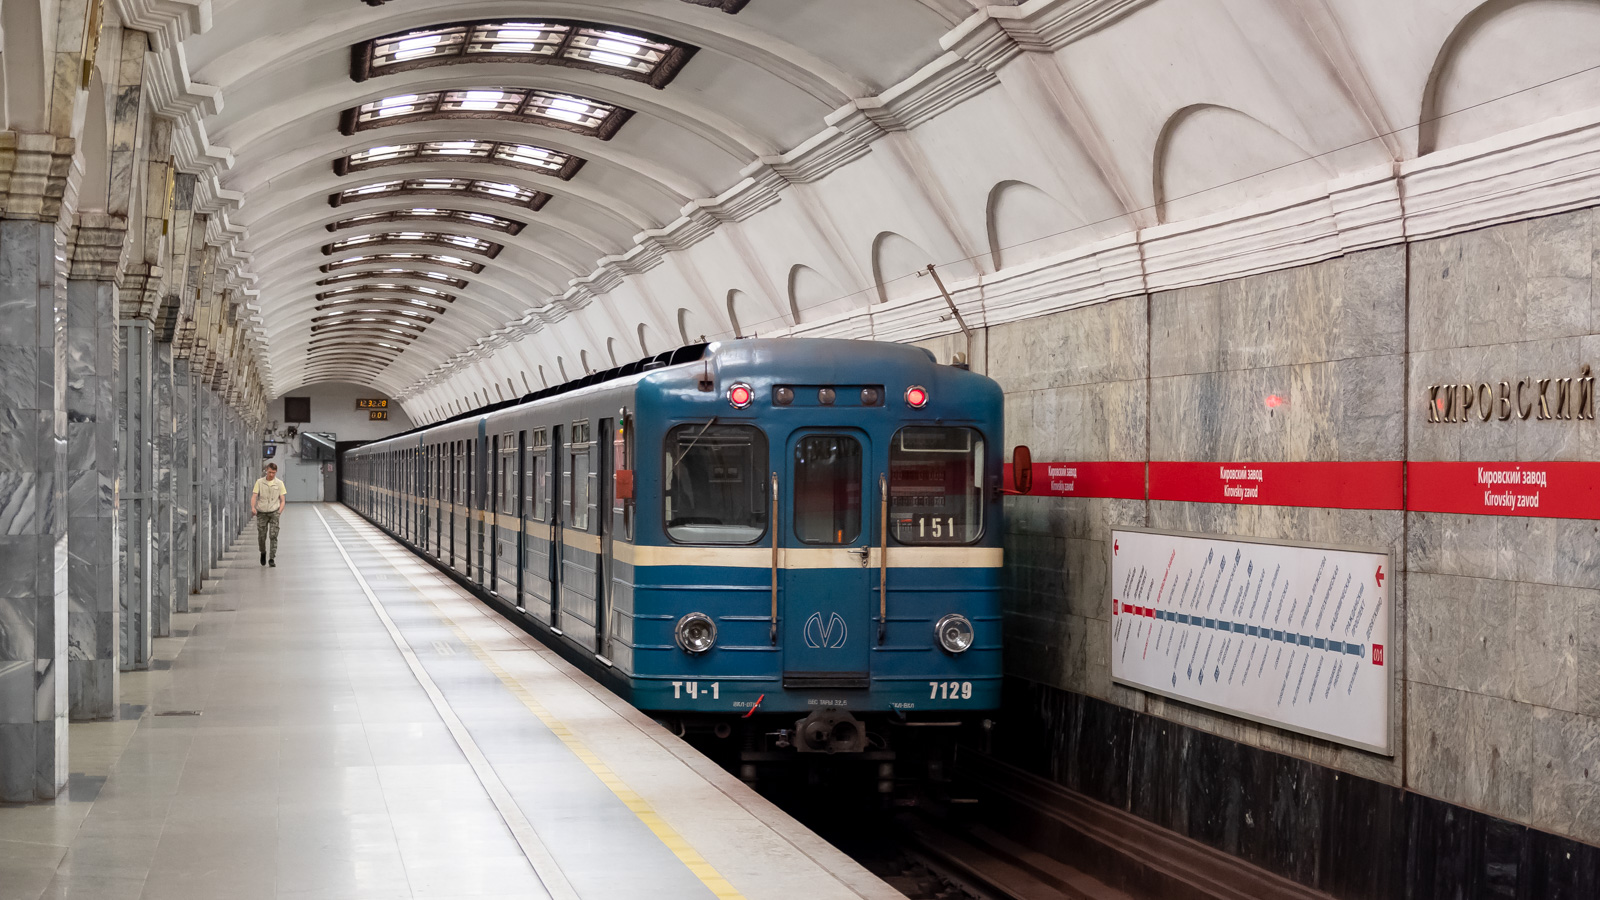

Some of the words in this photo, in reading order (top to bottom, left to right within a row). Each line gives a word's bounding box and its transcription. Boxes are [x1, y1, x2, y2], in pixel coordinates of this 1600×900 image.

[1427, 364, 1595, 423] КИРОВСКИЙ
[1220, 466, 1247, 483] Кировский
[1247, 470, 1263, 482] завод
[1478, 466, 1520, 488] Кировский
[1522, 471, 1546, 488] завод
[1224, 484, 1244, 500] Kirovskiy
[1244, 484, 1258, 498] zavod
[1484, 490, 1516, 511] Kirovskiy
[1517, 491, 1539, 507] zavod
[919, 518, 954, 537] 151
[672, 682, 719, 699] ТЧ-1
[929, 682, 972, 699] 7129
